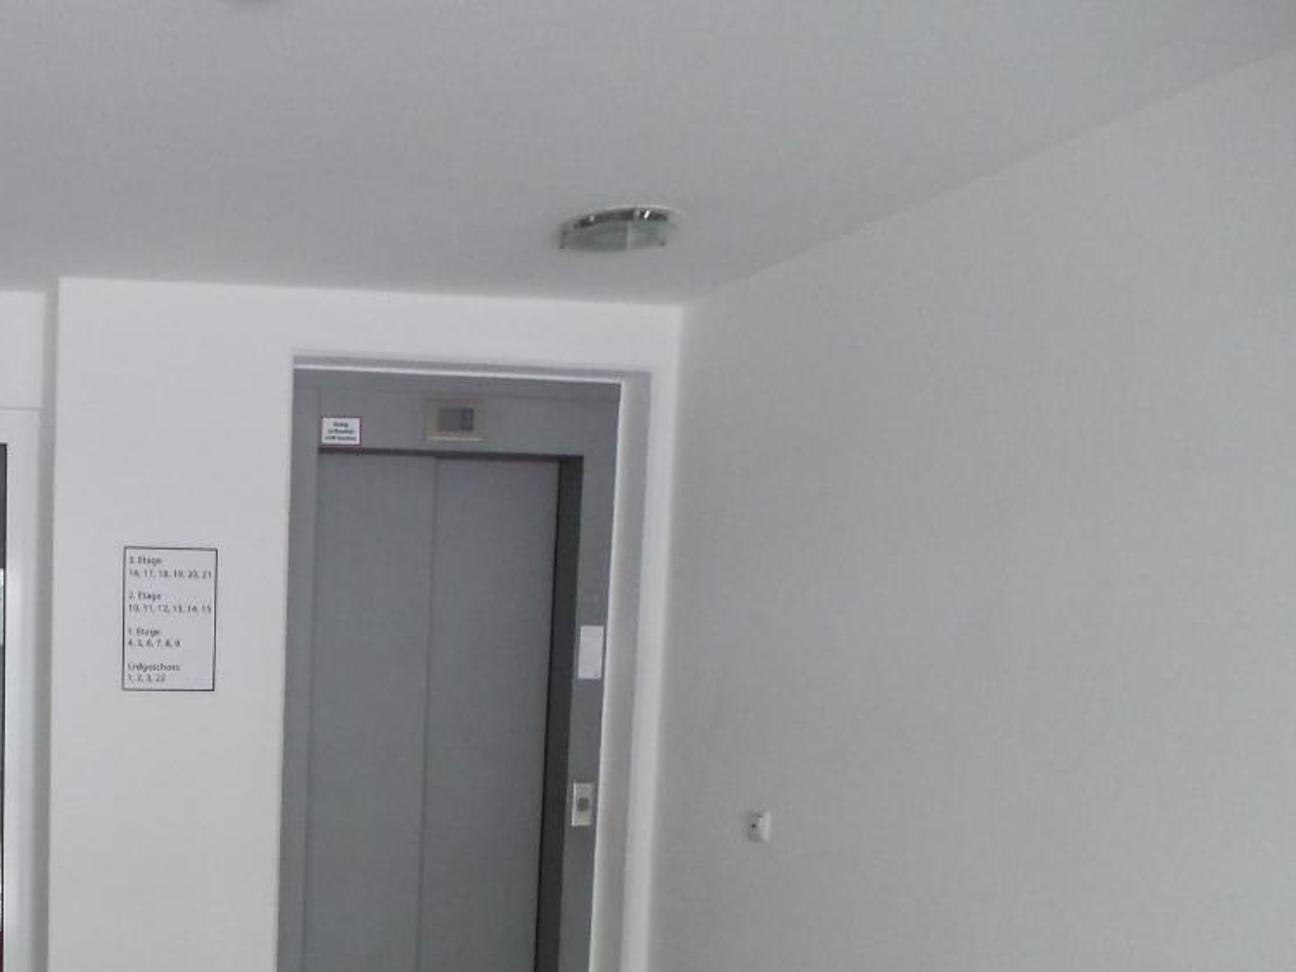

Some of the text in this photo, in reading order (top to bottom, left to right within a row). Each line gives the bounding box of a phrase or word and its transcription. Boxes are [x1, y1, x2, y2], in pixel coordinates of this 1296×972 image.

[138, 556, 162, 566] Etage
[138, 592, 161, 602] Etage
[136, 628, 161, 637] Etage
